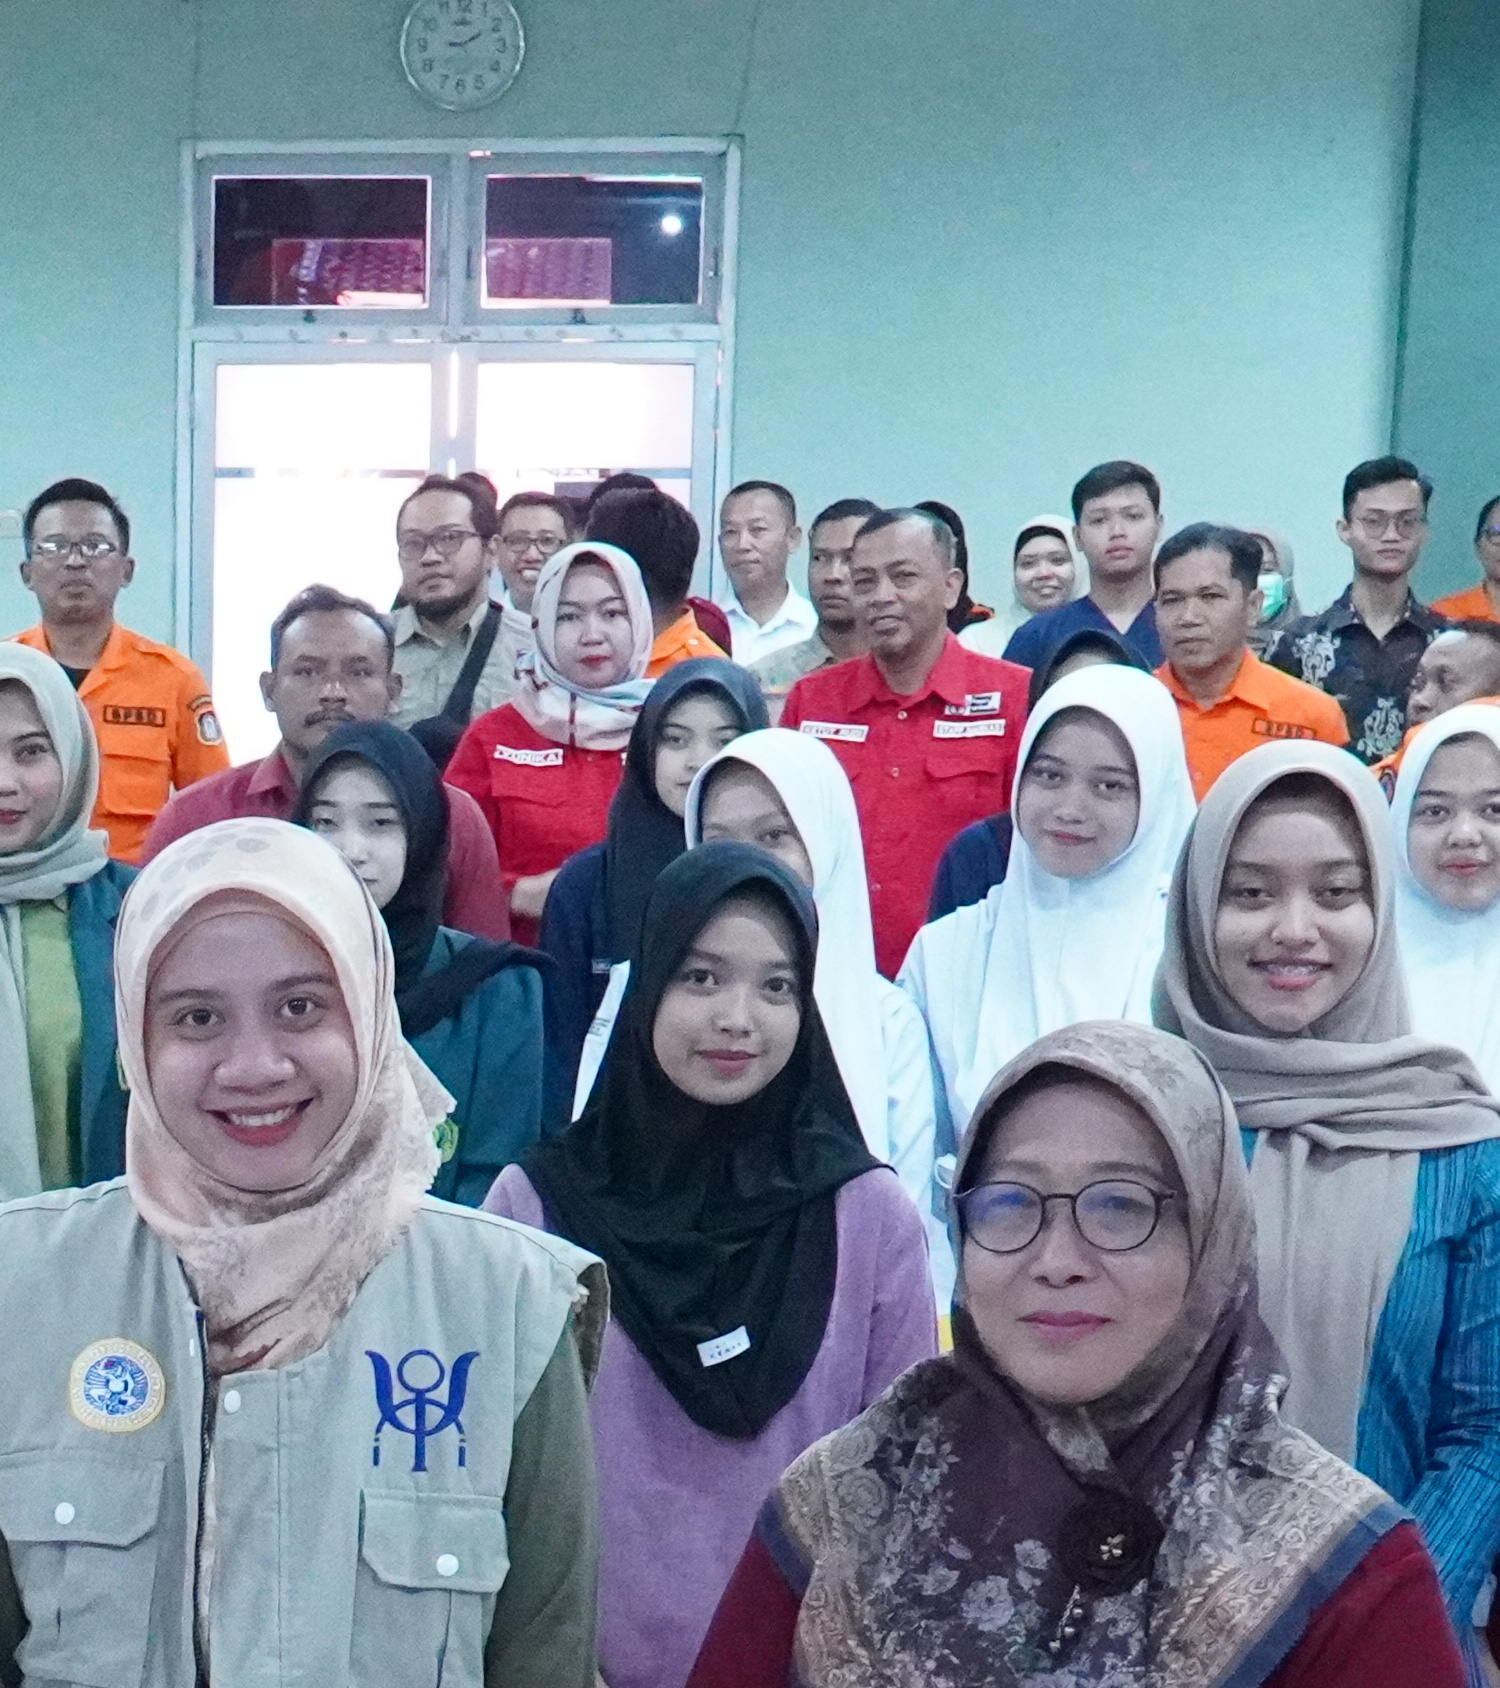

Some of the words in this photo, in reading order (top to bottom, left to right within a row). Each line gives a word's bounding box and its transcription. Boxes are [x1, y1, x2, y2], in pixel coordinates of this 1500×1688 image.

[418, 37, 428, 54] 9
[496, 37, 507, 54] 3
[422, 57, 433, 74] 8
[440, 74, 450, 89] 7
[455, 78, 466, 95] 6
